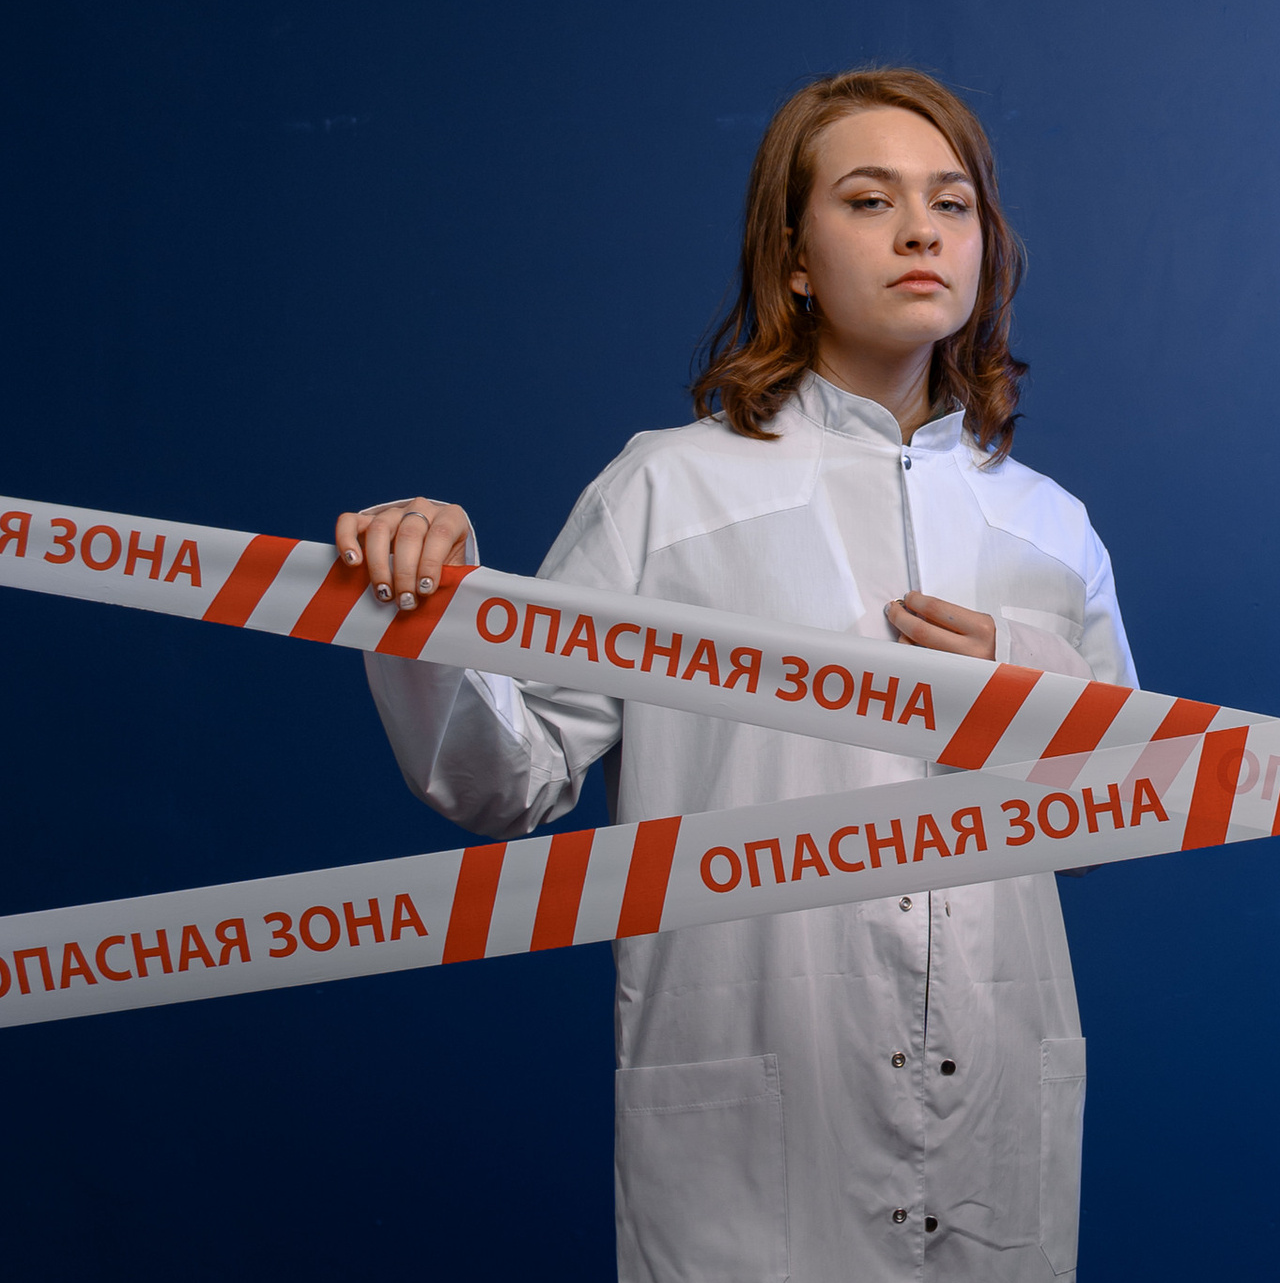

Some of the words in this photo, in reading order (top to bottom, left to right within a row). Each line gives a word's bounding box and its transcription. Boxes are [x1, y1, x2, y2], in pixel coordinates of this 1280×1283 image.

[43, 517, 203, 588] ЗОНА
[475, 597, 763, 694] ОПАСНАЯ
[775, 655, 937, 731] ЗОНА
[699, 806, 988, 894] ОПАСНАЯ
[1000, 777, 1169, 847] ЗОНА
[0, 917, 251, 998] ПАСНАЯ
[263, 893, 429, 959] ЗОНА
